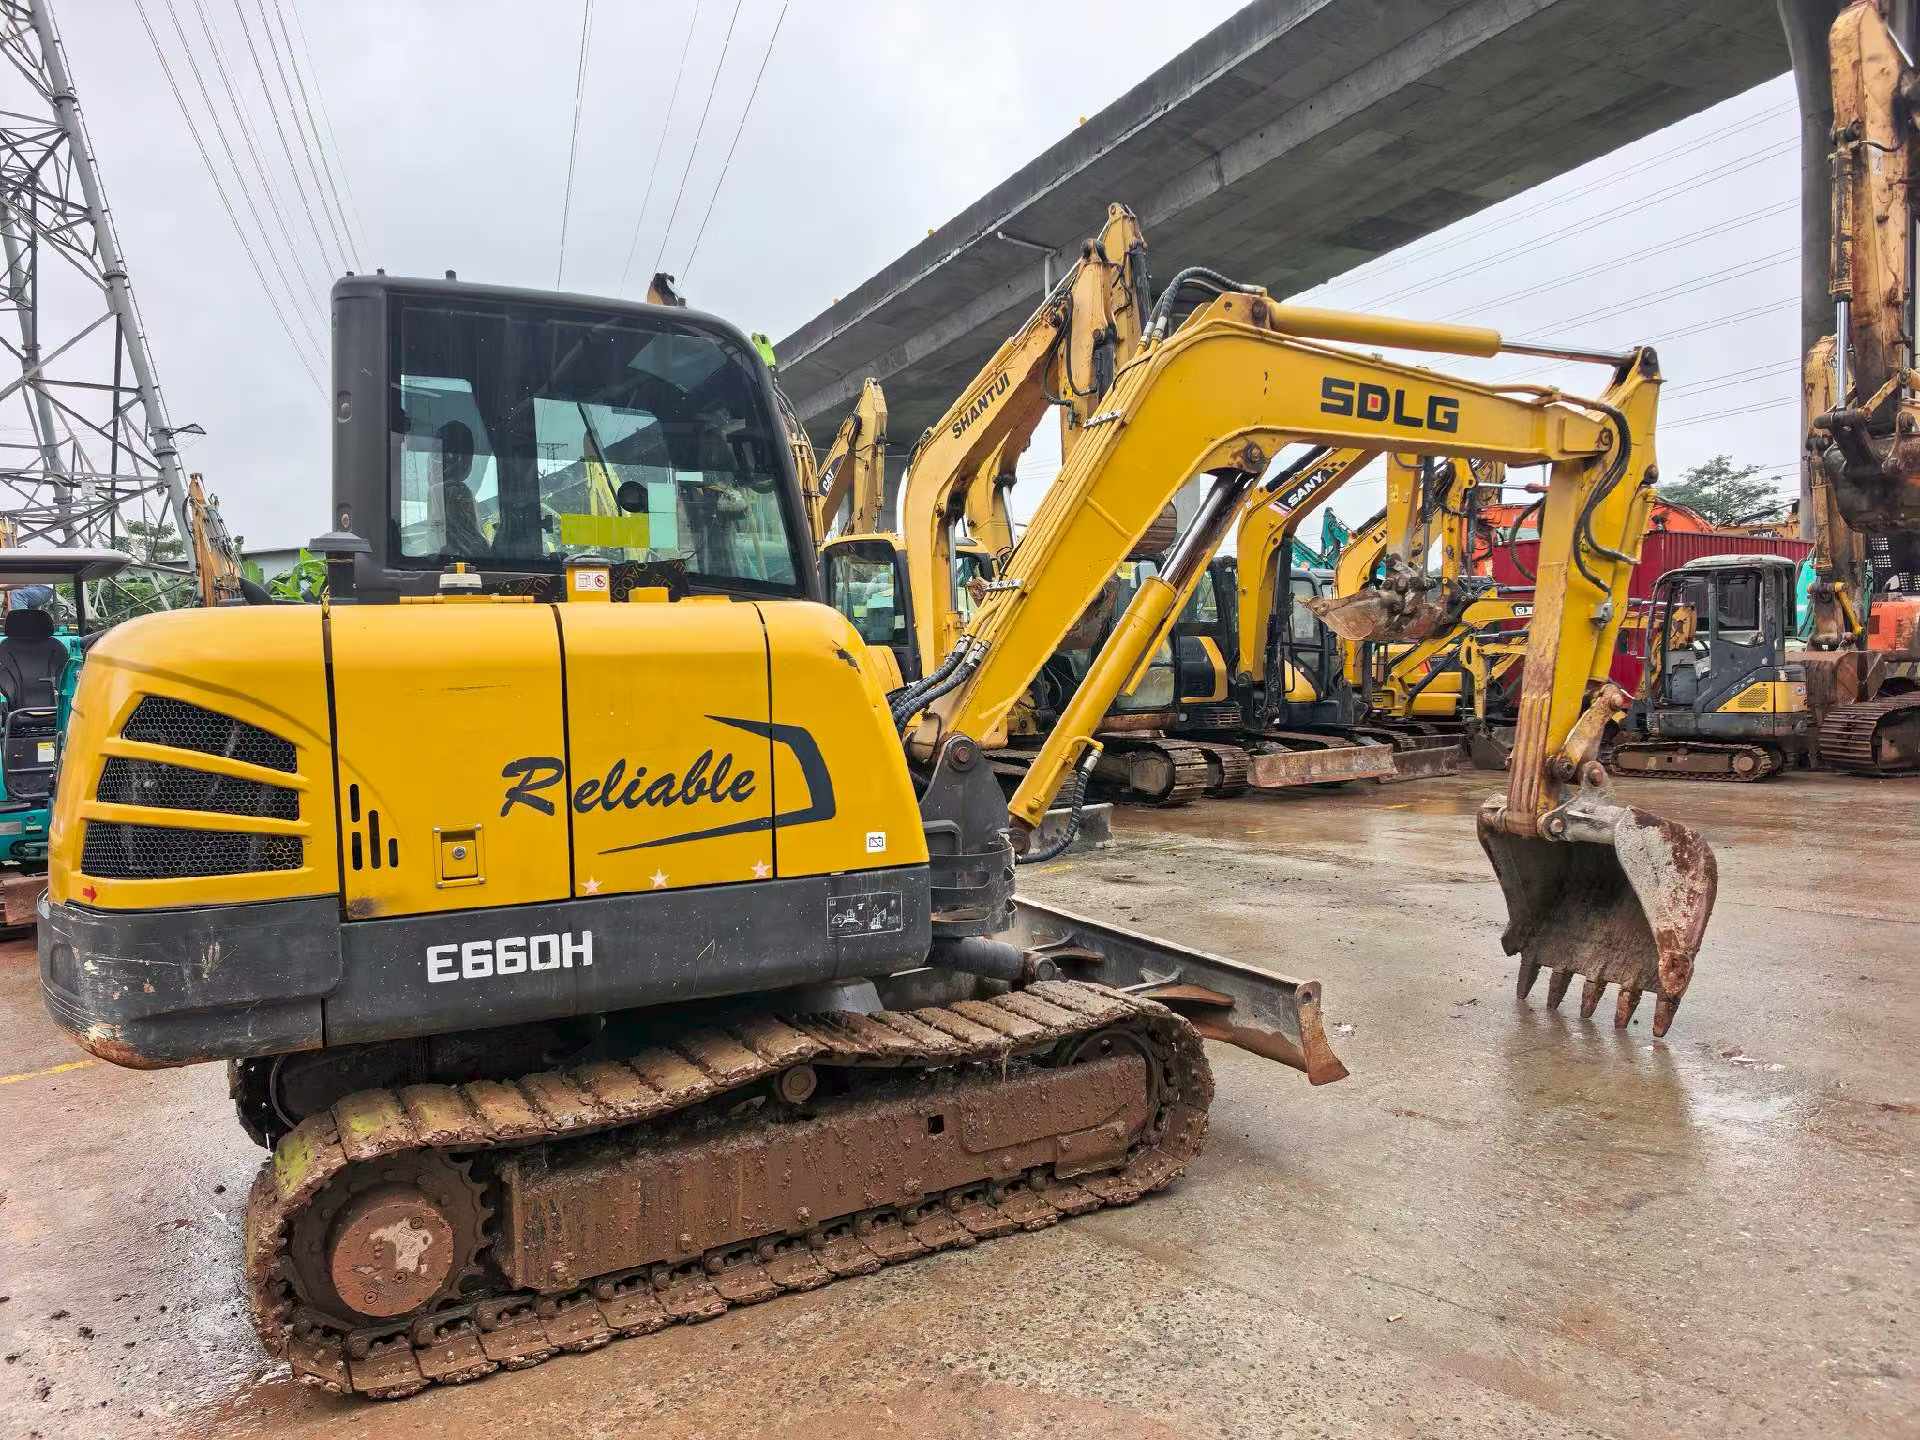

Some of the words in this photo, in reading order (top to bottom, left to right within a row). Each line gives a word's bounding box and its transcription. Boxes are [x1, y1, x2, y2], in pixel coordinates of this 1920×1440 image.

[952, 372, 1011, 439] SHANTUI
[1320, 376, 1460, 433] SDLG
[1287, 470, 1324, 507] SANY
[500, 748, 756, 817] Reliable
[426, 930, 593, 983] E660H
